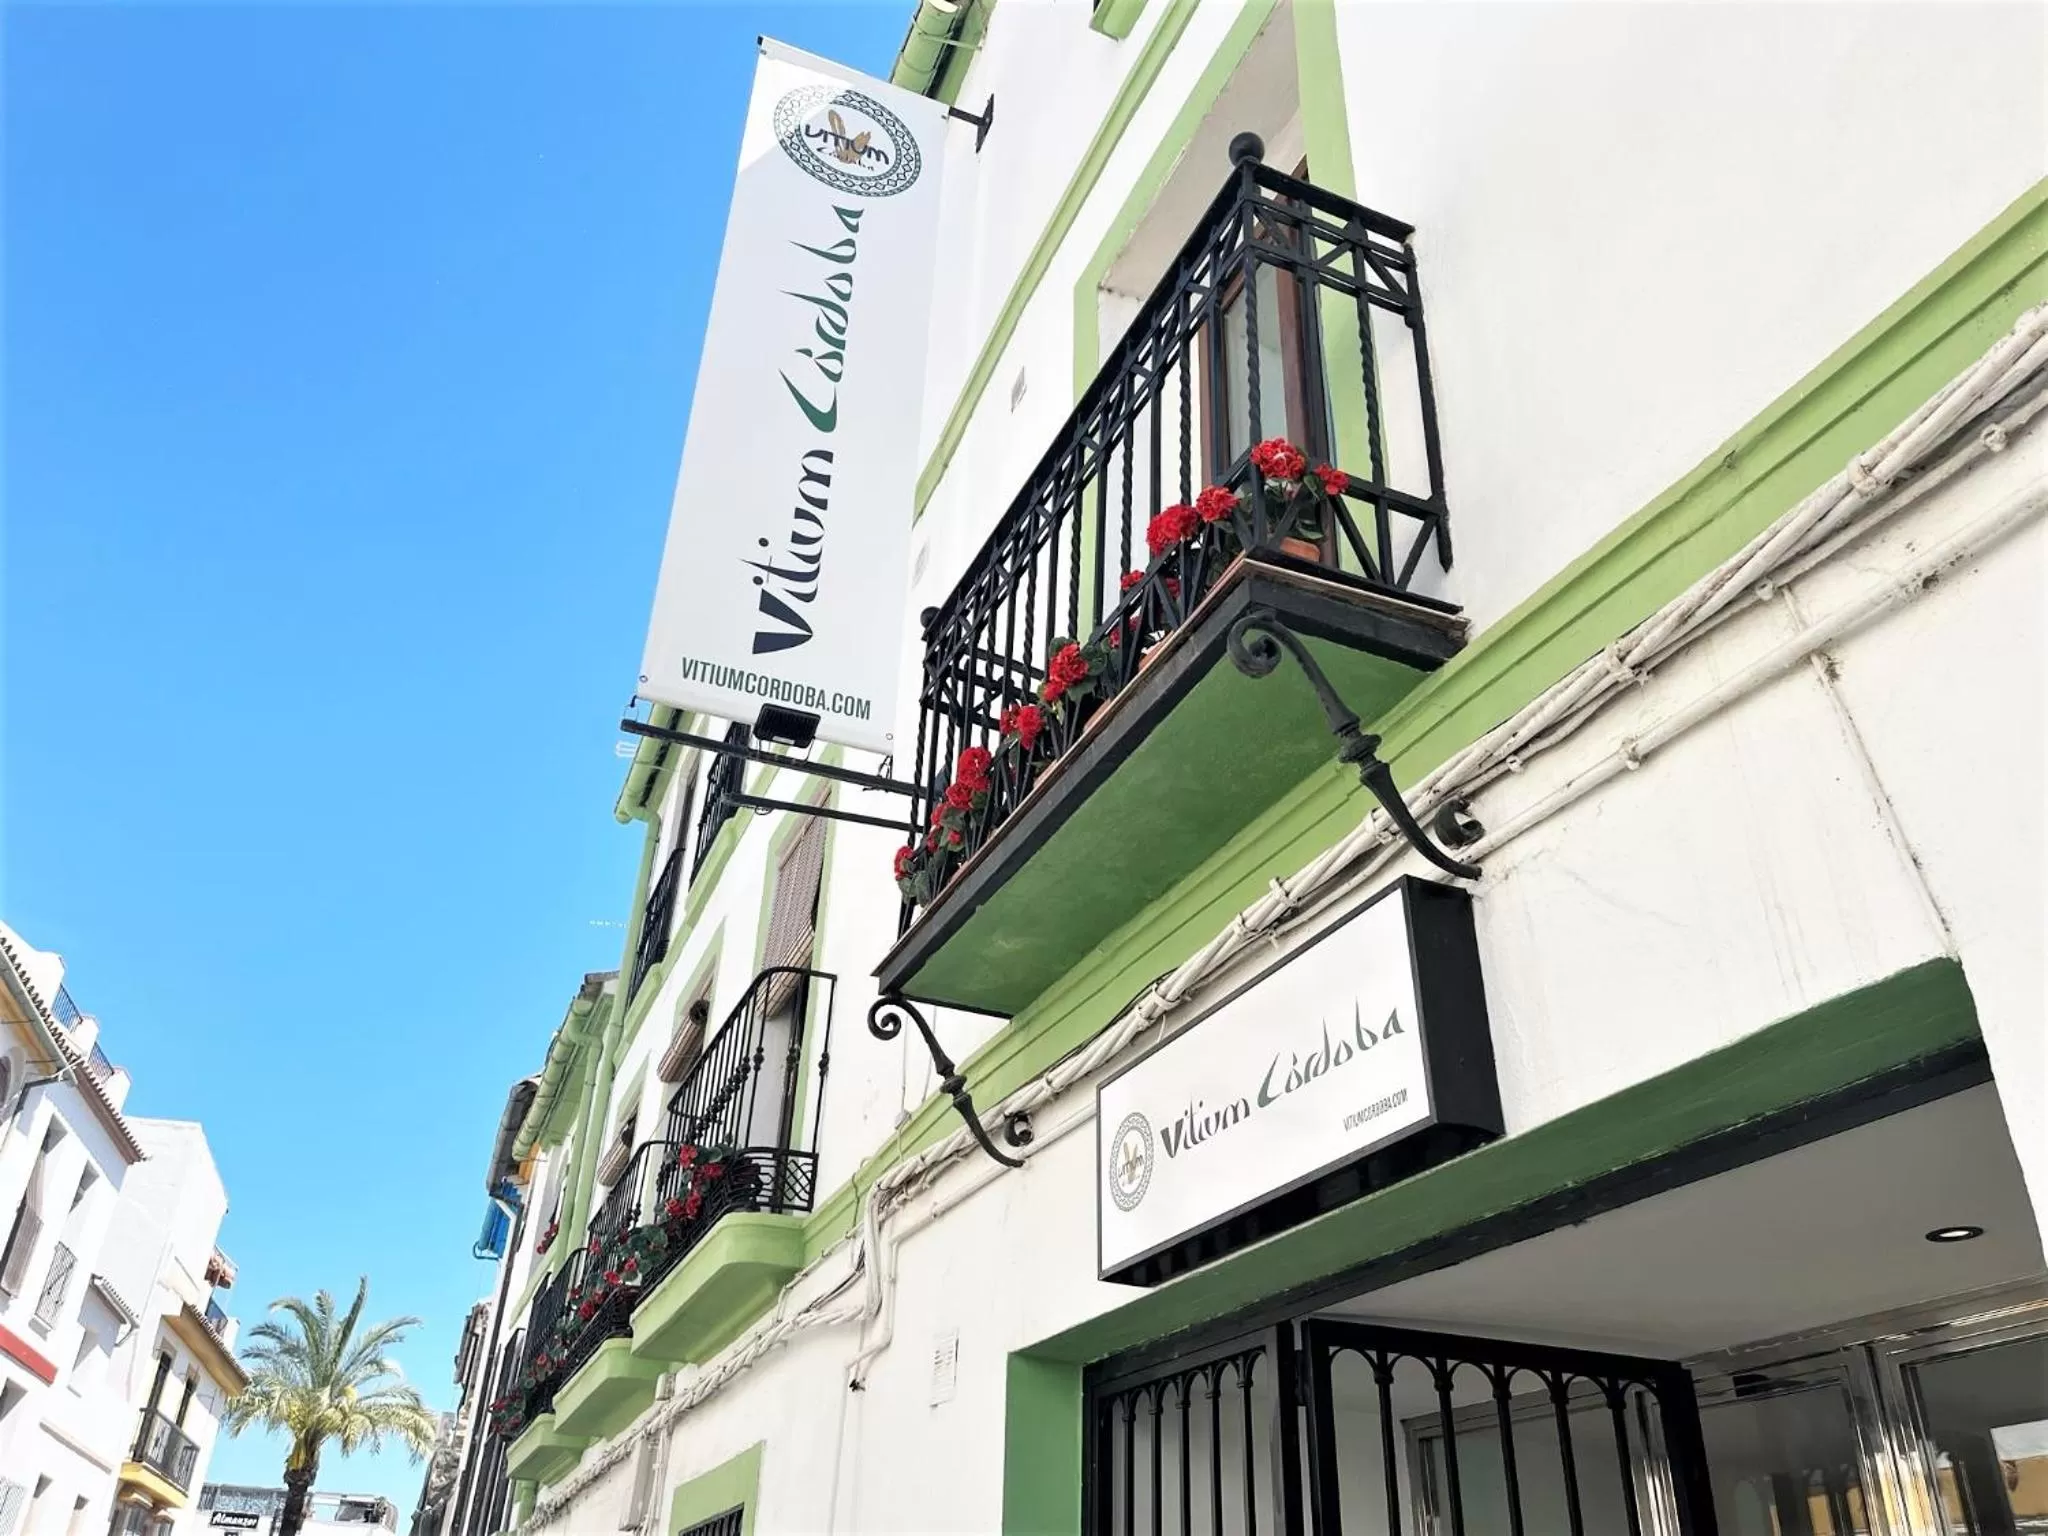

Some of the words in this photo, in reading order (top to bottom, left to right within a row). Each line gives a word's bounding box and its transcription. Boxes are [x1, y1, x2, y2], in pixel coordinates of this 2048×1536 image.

[738, 449, 834, 654] Vitium
[682, 657, 871, 720] VITIUMCORDOBA.COM
[1160, 1095, 1250, 1158] Vitium
